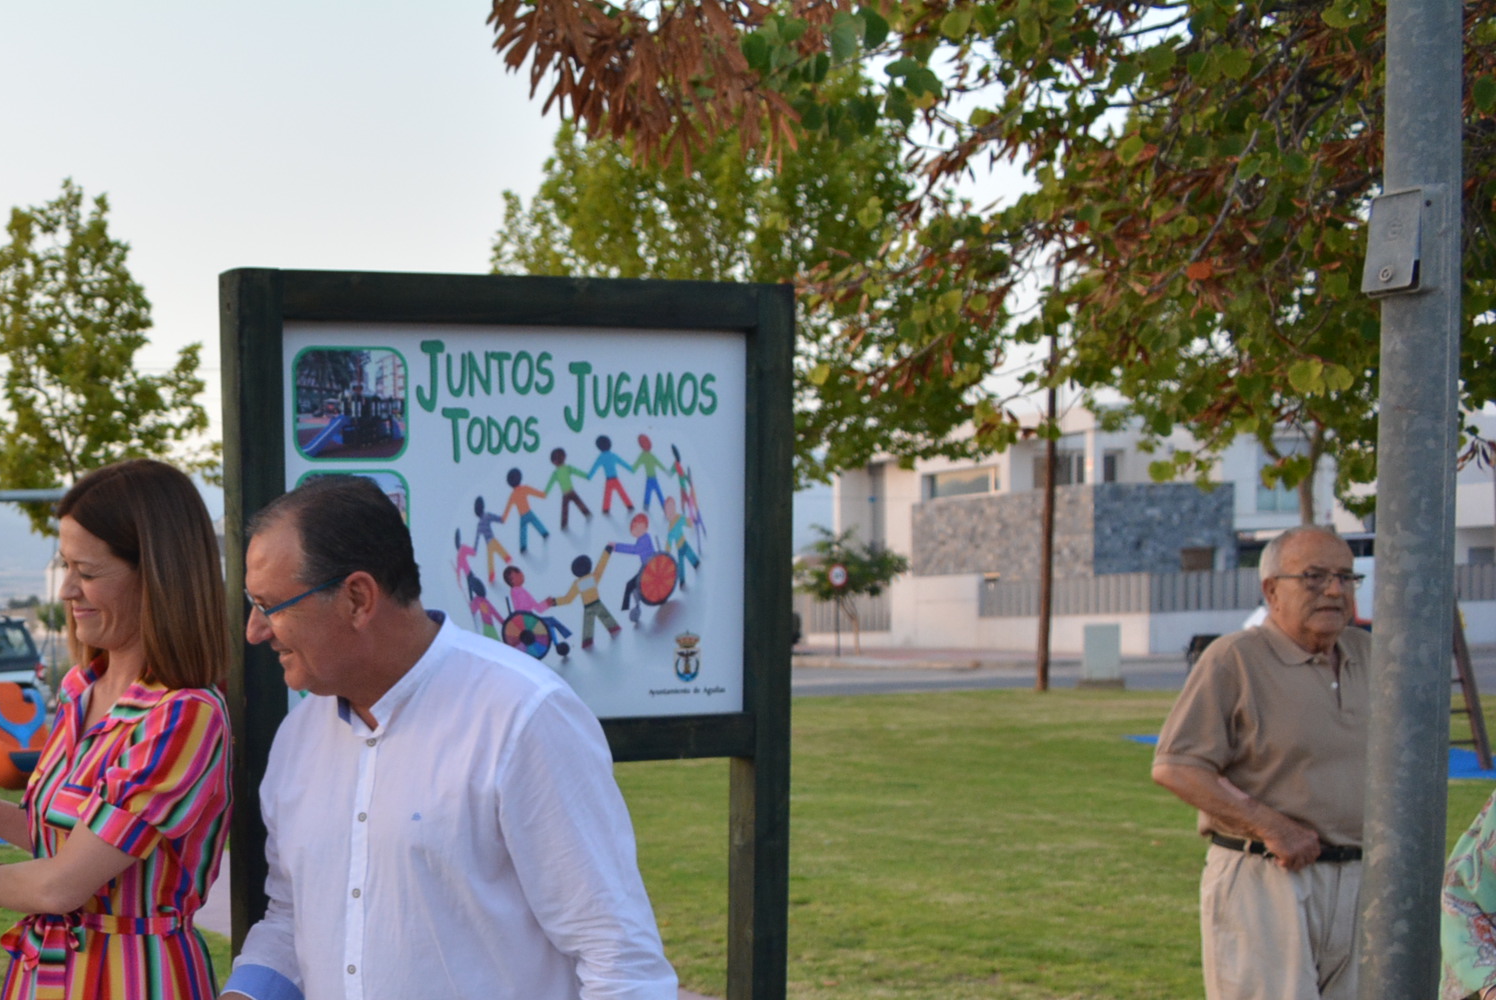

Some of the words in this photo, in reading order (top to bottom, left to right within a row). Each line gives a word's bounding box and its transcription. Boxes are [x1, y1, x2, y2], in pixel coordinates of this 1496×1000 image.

[416, 340, 554, 412] JUNTOS
[564, 361, 718, 432] JUGAMOS
[442, 407, 541, 463] TODOS
